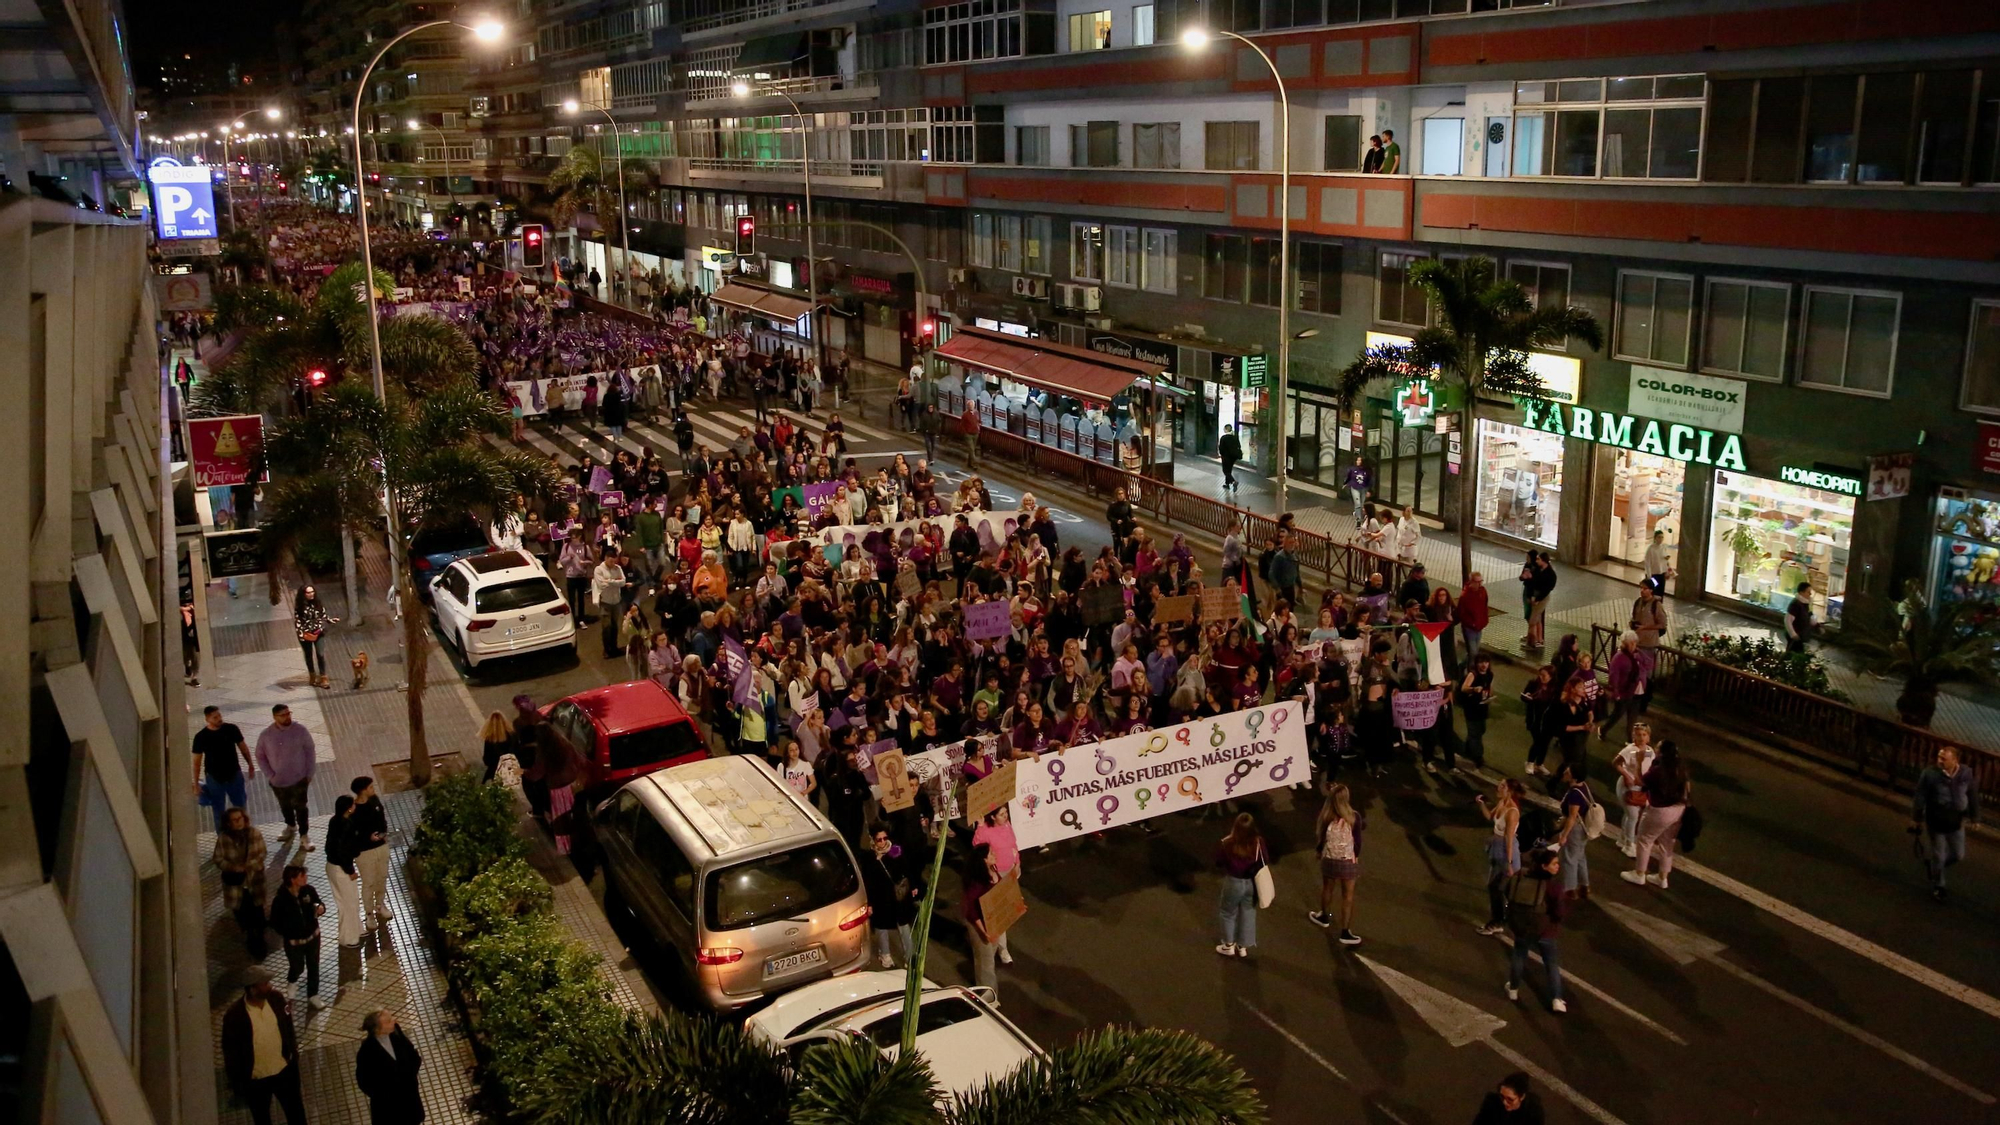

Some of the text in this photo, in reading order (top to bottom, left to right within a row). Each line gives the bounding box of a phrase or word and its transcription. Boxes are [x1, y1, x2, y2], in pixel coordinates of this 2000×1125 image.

[159, 186, 193, 224] P
[851, 274, 891, 293] TAMARAGUA
[1637, 378, 1739, 404] COLOR-BOX
[1521, 396, 1747, 471] FARMACIA
[1781, 466, 1862, 495] HOMEOPATI
[1046, 739, 1276, 804] JUNTAS, MÁS FUERTES, MÁS LEJOS
[1020, 784, 1039, 795] RED
[774, 951, 818, 970] 2720 BKC
